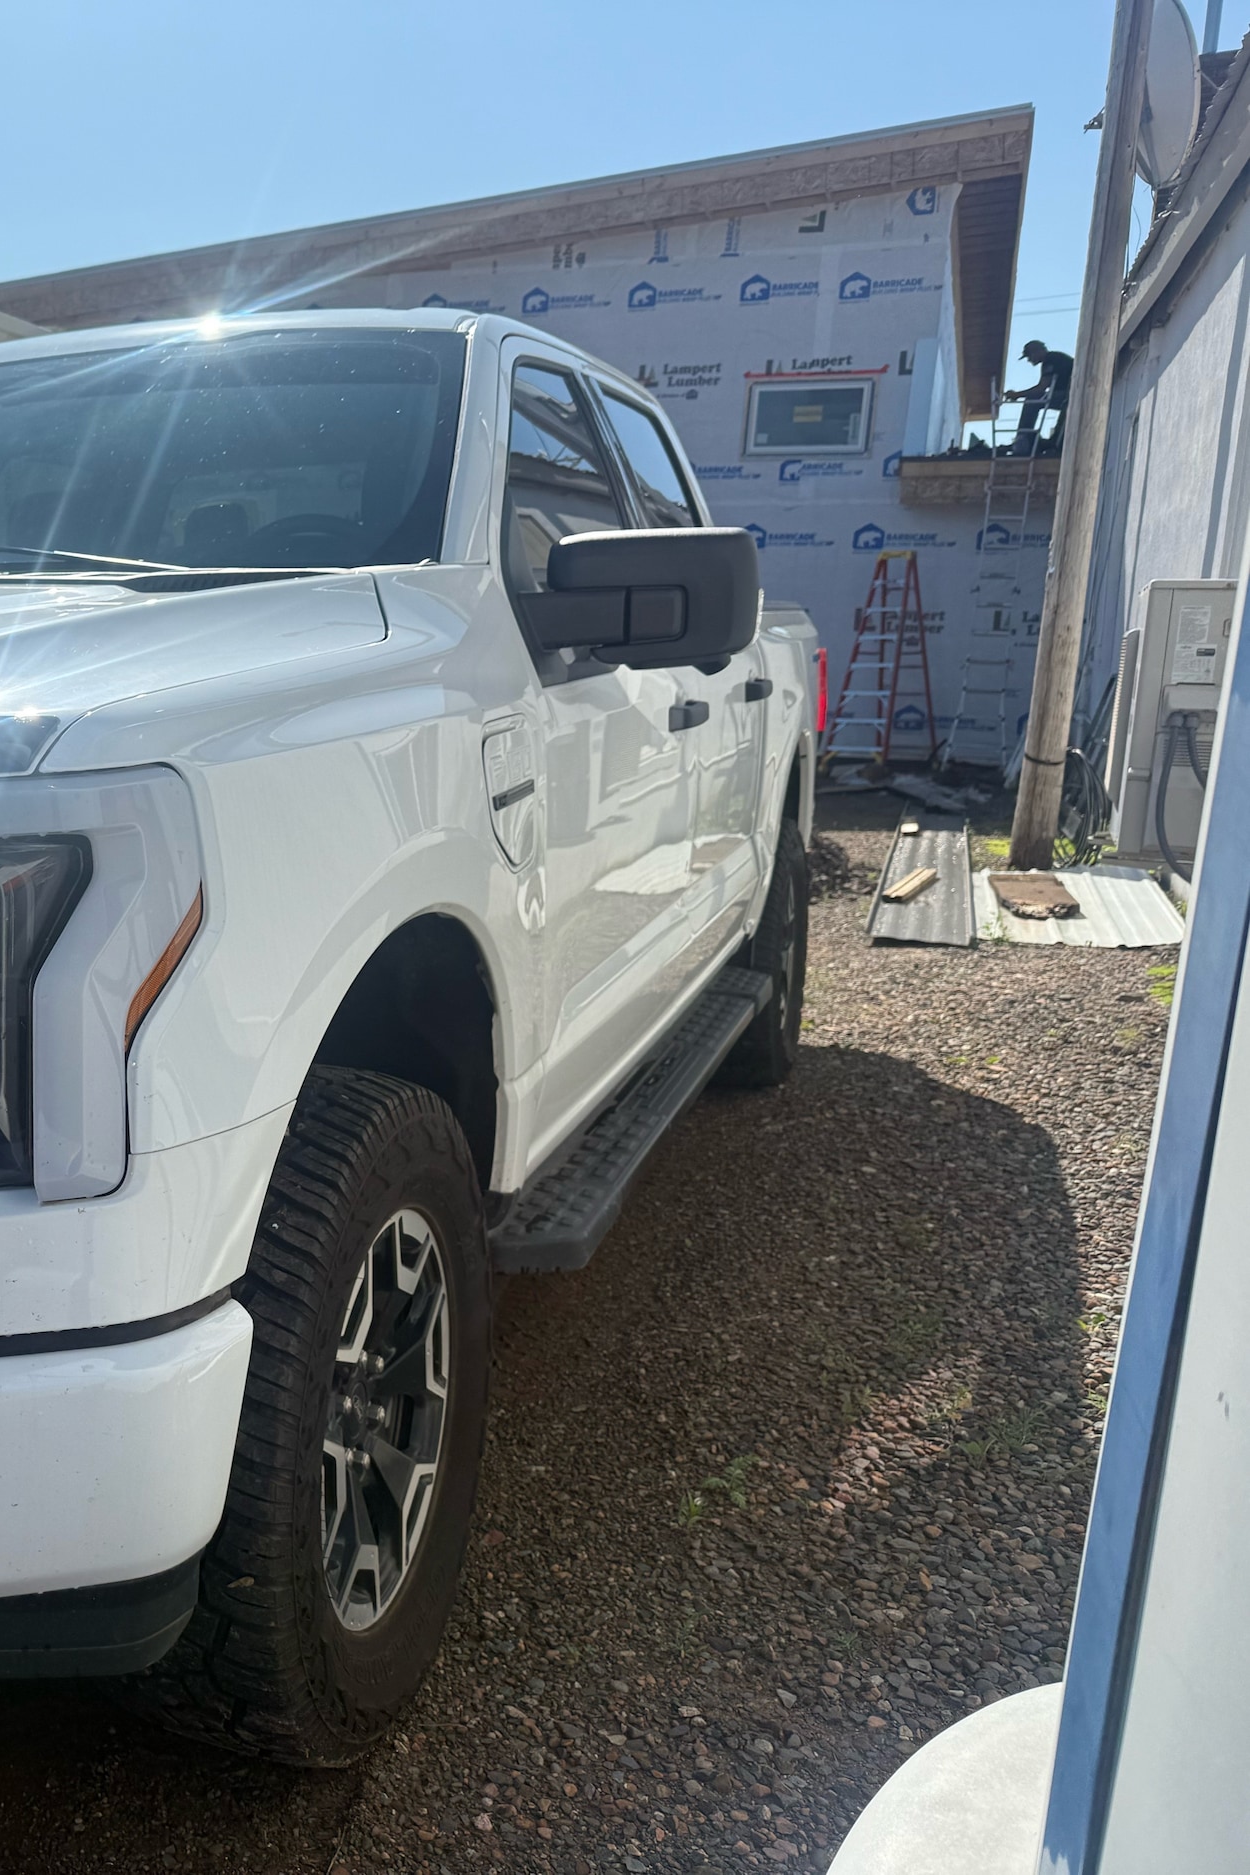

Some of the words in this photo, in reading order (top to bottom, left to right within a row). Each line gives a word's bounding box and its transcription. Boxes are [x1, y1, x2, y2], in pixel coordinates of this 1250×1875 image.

[772, 281, 819, 291] BARRICADE
[872, 277, 925, 288] BARRICADE
[662, 363, 722, 376] Lampert
[667, 375, 721, 388] Lumber
[768, 532, 817, 541] BARRICADE
[886, 532, 938, 541] BARRICADE
